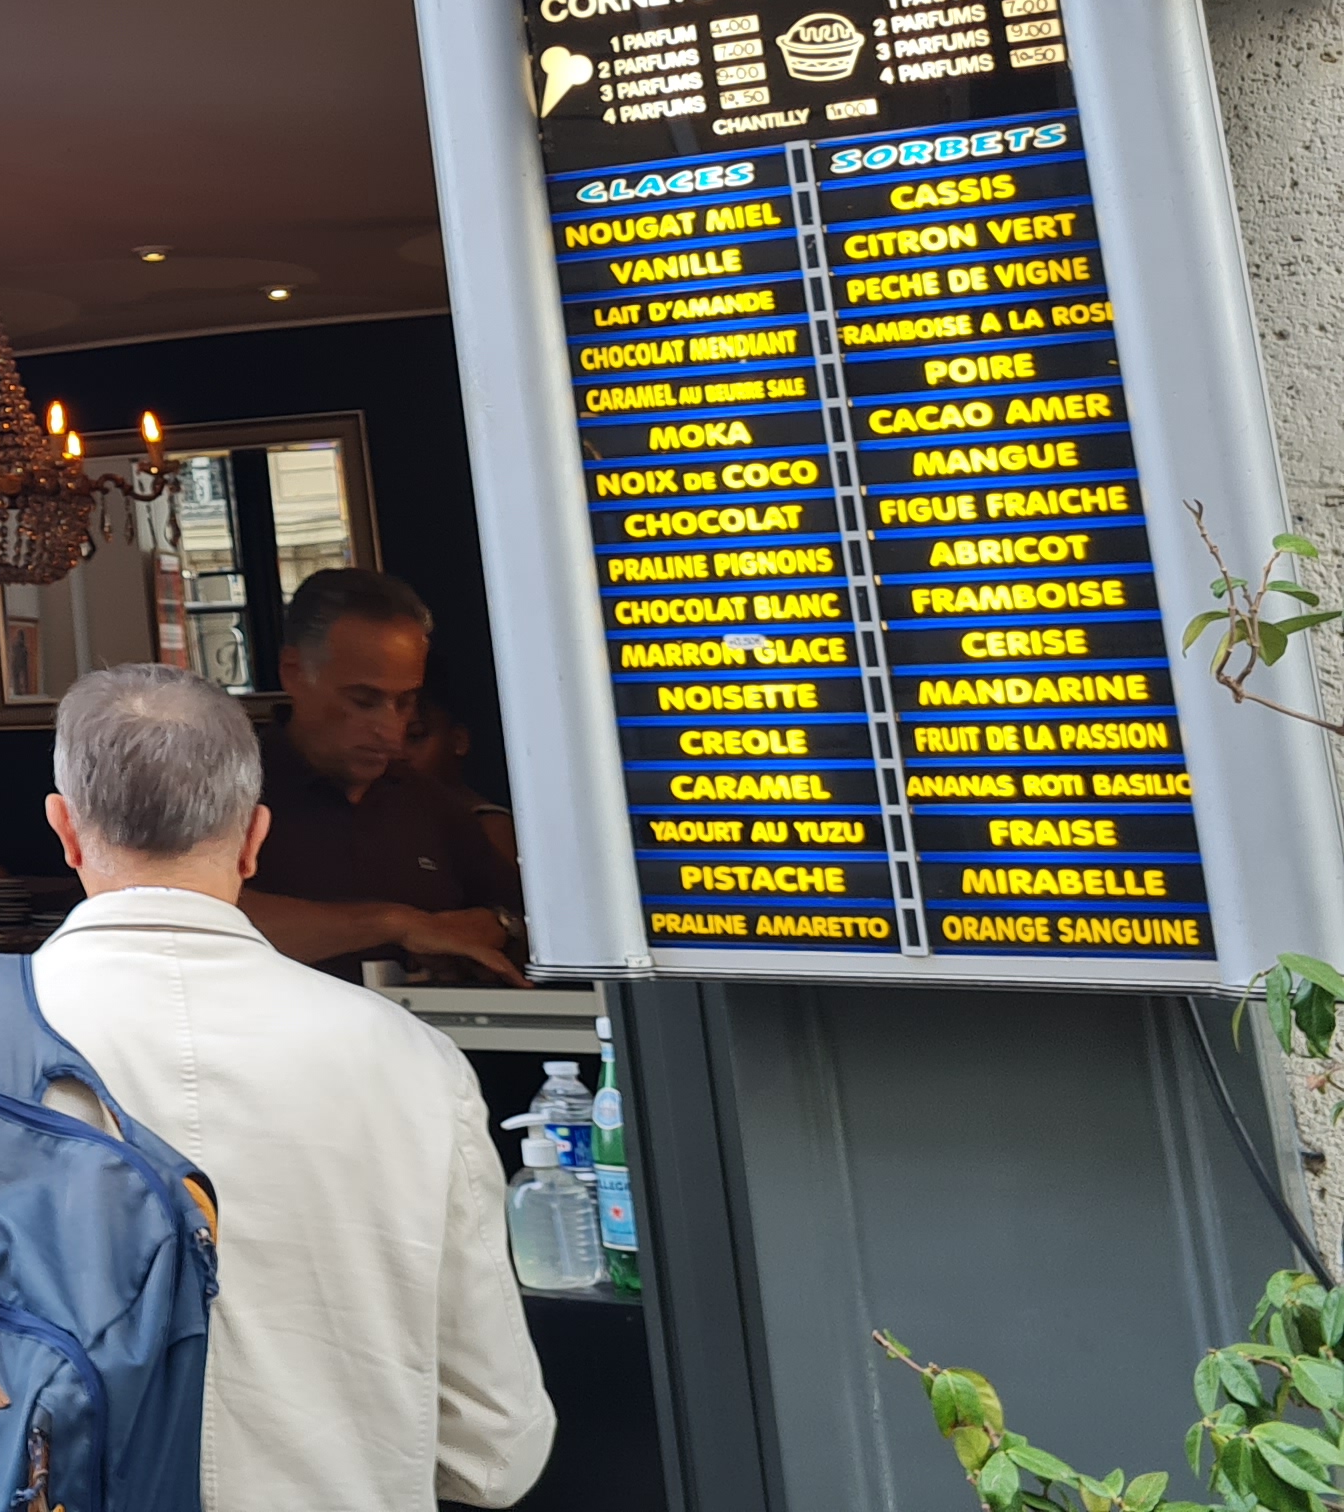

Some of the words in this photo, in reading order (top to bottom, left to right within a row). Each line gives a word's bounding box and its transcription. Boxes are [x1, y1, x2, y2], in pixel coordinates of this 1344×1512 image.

[873, 18, 888, 37] 2
[891, 4, 986, 34] PARFUMS
[610, 36, 620, 52] 1
[623, 25, 697, 50] PARFUM
[876, 43, 890, 61] 3
[894, 29, 991, 58] PARFUMS
[598, 62, 610, 79] 2
[614, 49, 699, 76] PARFUMS
[879, 68, 894, 84] 4
[898, 53, 995, 83] PARFUMS
[599, 85, 613, 102] 3
[617, 73, 703, 99] PARFUMS
[603, 109, 616, 124] 4
[620, 96, 707, 123] PARFUMS
[712, 108, 810, 135] CHANTILLY
[830, 123, 1066, 174] SORBETS
[576, 162, 754, 203] GLACES
[890, 174, 1016, 210] CASSIS
[565, 211, 696, 248] NOUGAT
[705, 203, 781, 232] MIEL
[844, 222, 978, 259] CITRON
[987, 212, 1076, 244] VERT
[611, 249, 742, 284] VANILLE
[846, 271, 941, 303] PECHE
[948, 266, 988, 293] DE
[994, 256, 1090, 288] VIGNE
[594, 304, 641, 327] LAIT
[648, 290, 775, 322] D'AMANDE
[980, 312, 1002, 333] A
[1009, 308, 1044, 330] LA
[580, 339, 685, 371] CHOCOLAT
[690, 330, 797, 361] MENDIANT
[924, 353, 1036, 386] POIRE
[586, 383, 677, 412] CARAMEL
[679, 386, 702, 404] AU
[767, 377, 806, 397] SALE
[868, 401, 994, 434] CACAO
[1005, 393, 1111, 424] AMER
[649, 421, 753, 450] MOKA
[913, 442, 1079, 476] MANGUE
[596, 469, 678, 497] NOIX
[683, 472, 717, 491] DE
[722, 460, 818, 488] COCO
[879, 495, 978, 524] FIGUE
[986, 485, 1129, 518] FRAICHE
[624, 505, 802, 538] CHOCOLAT
[608, 555, 709, 582] PRALINE
[713, 548, 833, 577] PIGNONS
[930, 535, 1090, 567] ABRICOT
[614, 597, 747, 624] CHOCOLAT
[753, 593, 841, 620] BLANC
[911, 580, 1126, 614] FRAMBOISE
[621, 641, 746, 668] MARRON
[753, 638, 848, 665] GLACE
[961, 629, 1089, 658] CERISE
[658, 683, 818, 711] NOISETTE
[918, 674, 1149, 706] MANDARINE
[679, 729, 808, 755] CREOLE
[914, 726, 980, 752] FRUIT
[985, 726, 1020, 751] DE
[1023, 724, 1056, 750] LA
[1059, 722, 1168, 750] PASSION
[670, 775, 831, 800] CARAMEL
[907, 775, 1015, 797] ANANAS
[1022, 775, 1085, 796] ROTI
[649, 821, 744, 842] YAOURT
[751, 822, 788, 843] AU
[794, 822, 864, 843] YUZU
[989, 820, 1118, 846] FRAISE
[680, 866, 846, 892] PISTACHE
[962, 869, 1166, 895] MIRABELLE
[651, 913, 748, 935] PRALINE
[756, 915, 890, 938] AMARETTO
[942, 915, 1051, 942] ORANGE
[1057, 916, 1200, 945] SANGUINE
